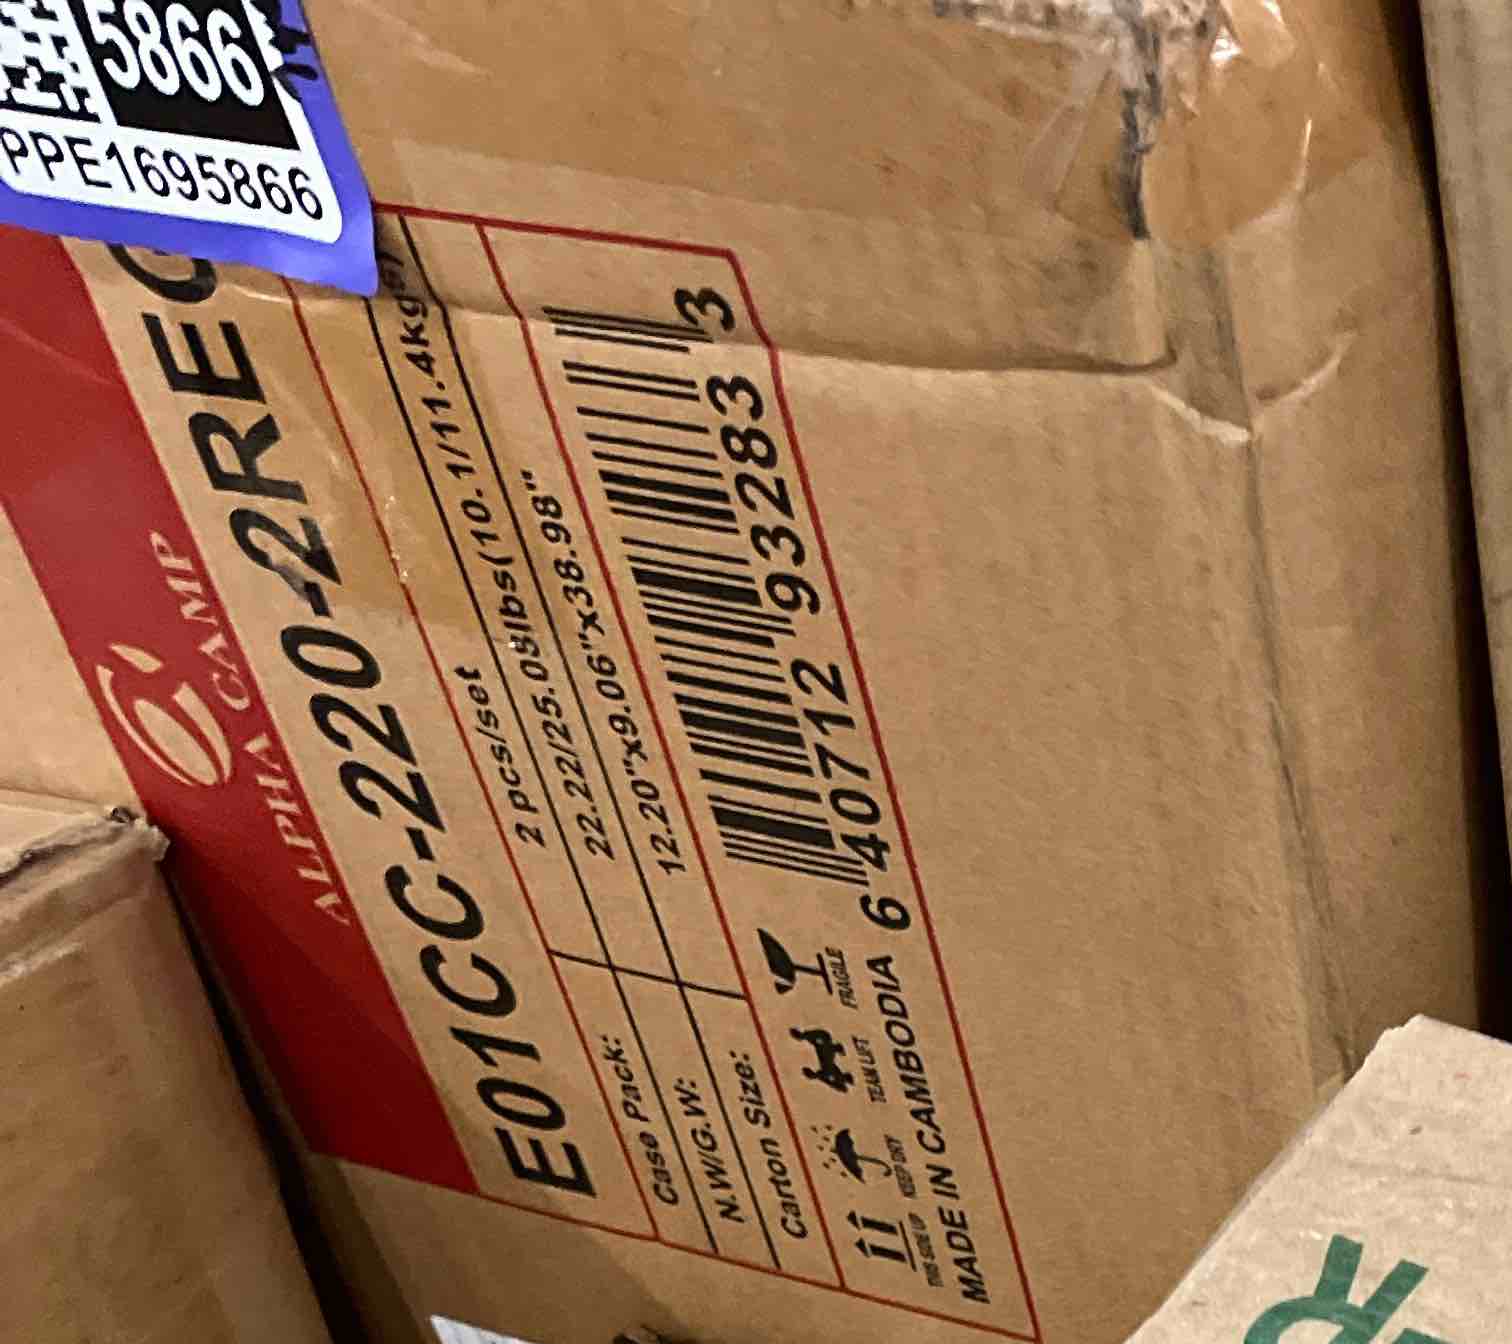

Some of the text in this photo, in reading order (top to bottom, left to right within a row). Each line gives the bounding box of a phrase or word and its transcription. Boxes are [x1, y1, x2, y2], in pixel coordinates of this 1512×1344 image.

[86, 0, 265, 107] 5866
[0, 126, 324, 221] PPE1695866
[677, 287, 911, 931] 6 40712 93283 3
[149, 530, 351, 926] ALPHA CAMP
[454, 665, 546, 849] 2 pcs/set
[825, 947, 858, 1010] FRAGILE
[601, 1034, 679, 1206] Case Pack:
[730, 1050, 809, 1239] Carton Size:
[851, 1035, 887, 1103] TEAM LIFT
[866, 955, 991, 1304] MADE IN CAMBODIA
